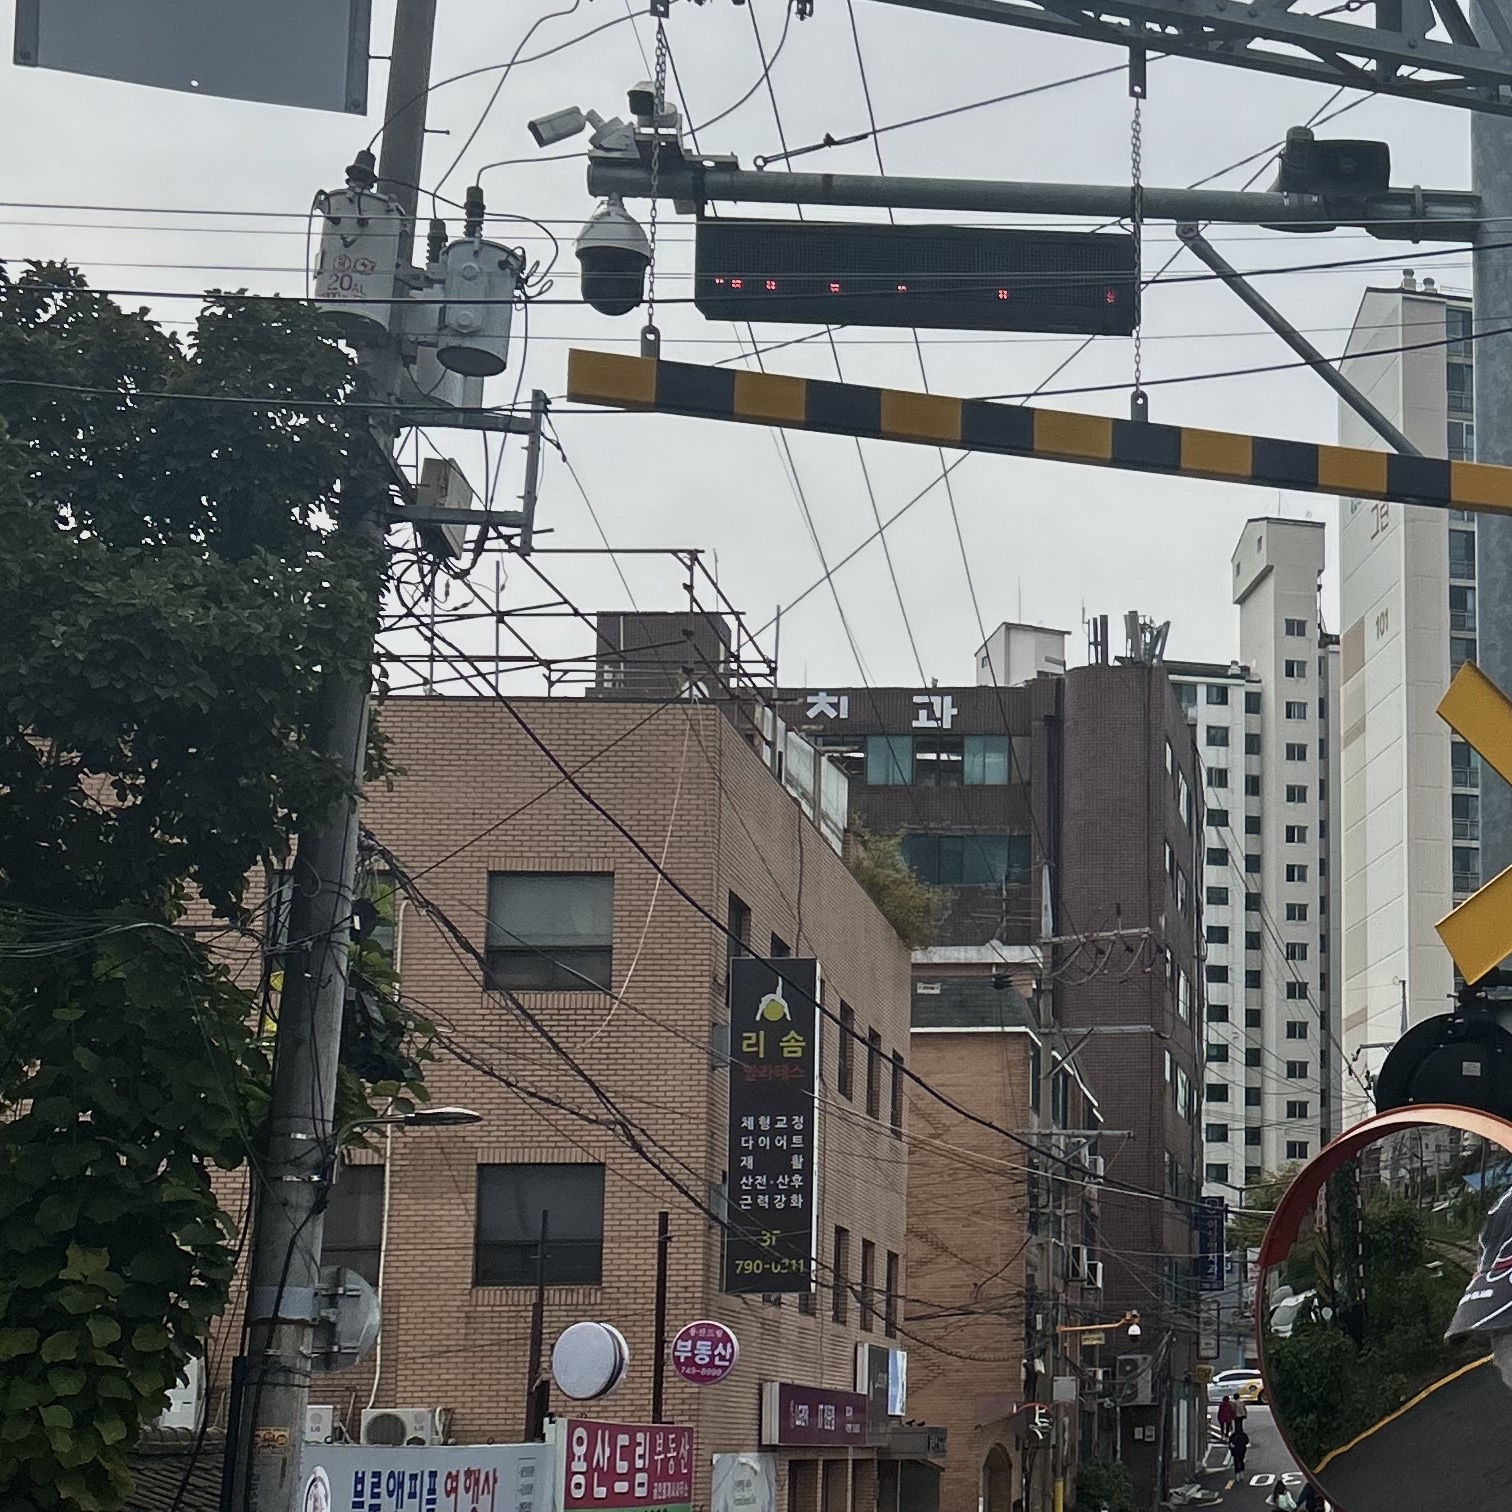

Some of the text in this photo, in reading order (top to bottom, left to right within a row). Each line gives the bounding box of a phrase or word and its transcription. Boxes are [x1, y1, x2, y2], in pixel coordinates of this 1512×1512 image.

[1375, 606, 1389, 641] 101
[742, 1030, 806, 1058] 리솜
[741, 1116, 804, 1130] 체형교정
[741, 1135, 804, 1150] 다이어트
[739, 1194, 803, 1209] 근력강화
[674, 1339, 732, 1366] 부동산
[571, 1427, 651, 1499] 용산드림
[654, 1431, 690, 1477] 부동산
